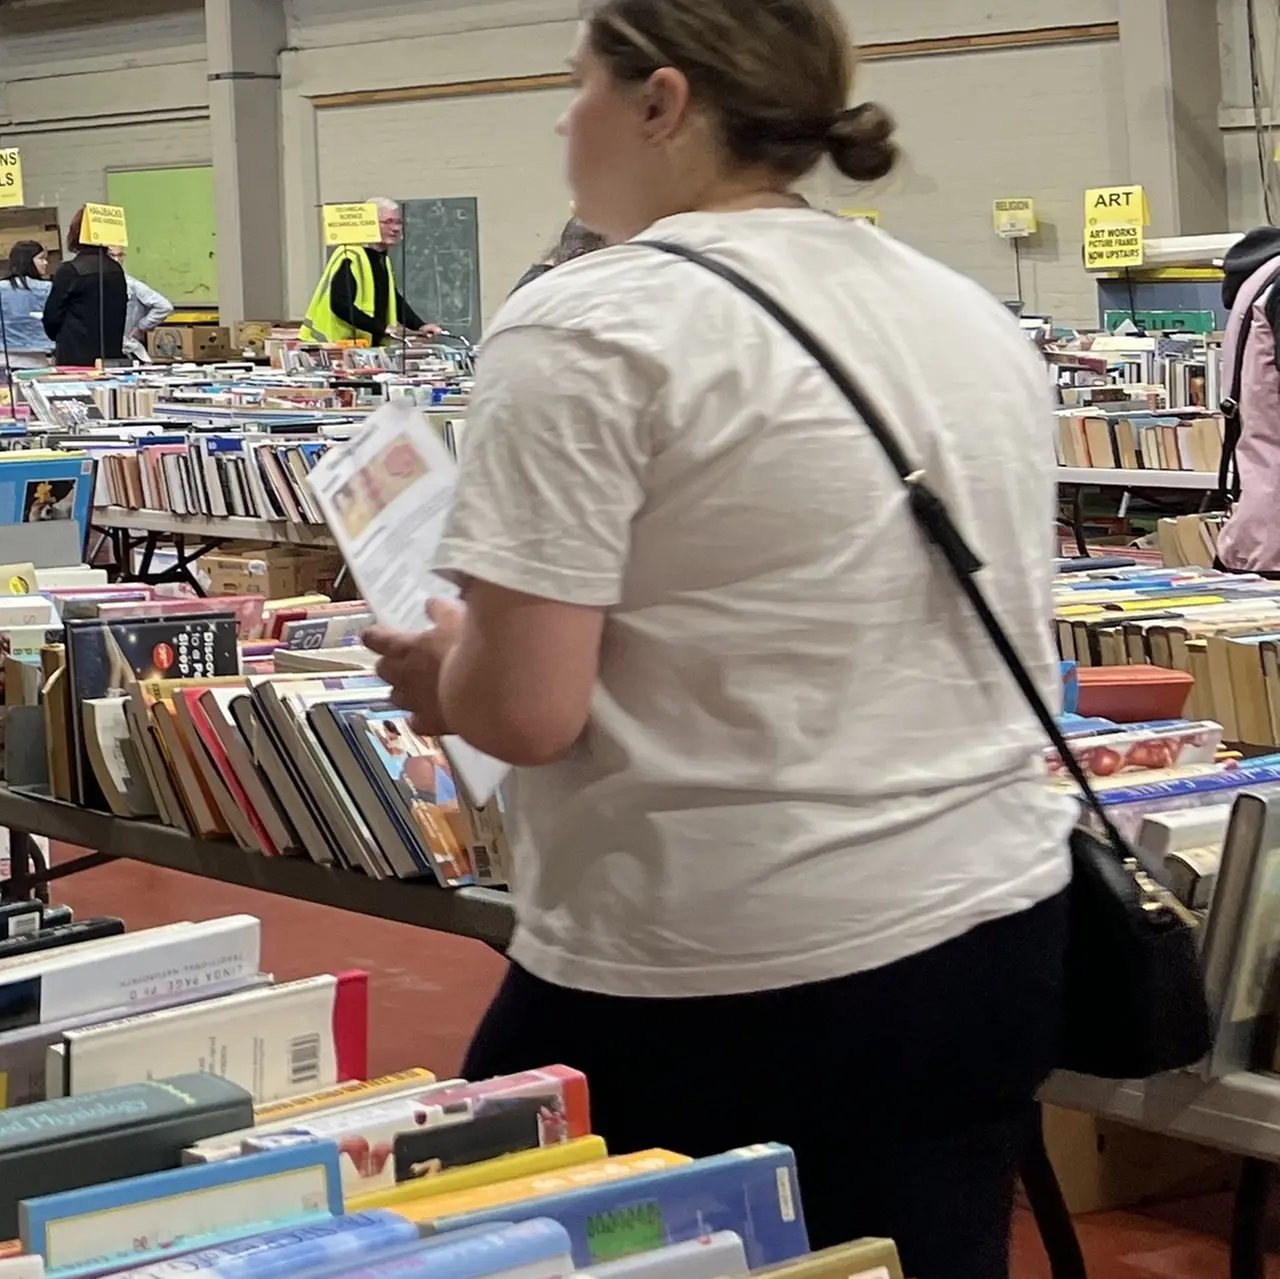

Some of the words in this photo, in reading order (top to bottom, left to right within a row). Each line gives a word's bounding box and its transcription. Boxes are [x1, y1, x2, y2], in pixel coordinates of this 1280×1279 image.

[996, 201, 1029, 211] RELIGION
[1094, 192, 1134, 208] ART
[1089, 230, 1105, 239] ART
[1107, 228, 1137, 238] WORKS
[1088, 239, 1113, 248] PICTURE
[1088, 252, 1104, 261] NOW
[1106, 249, 1139, 260] UPSTAIRS
[179, 633, 189, 674] Sleep
[31, 1097, 148, 1130] Physiology
